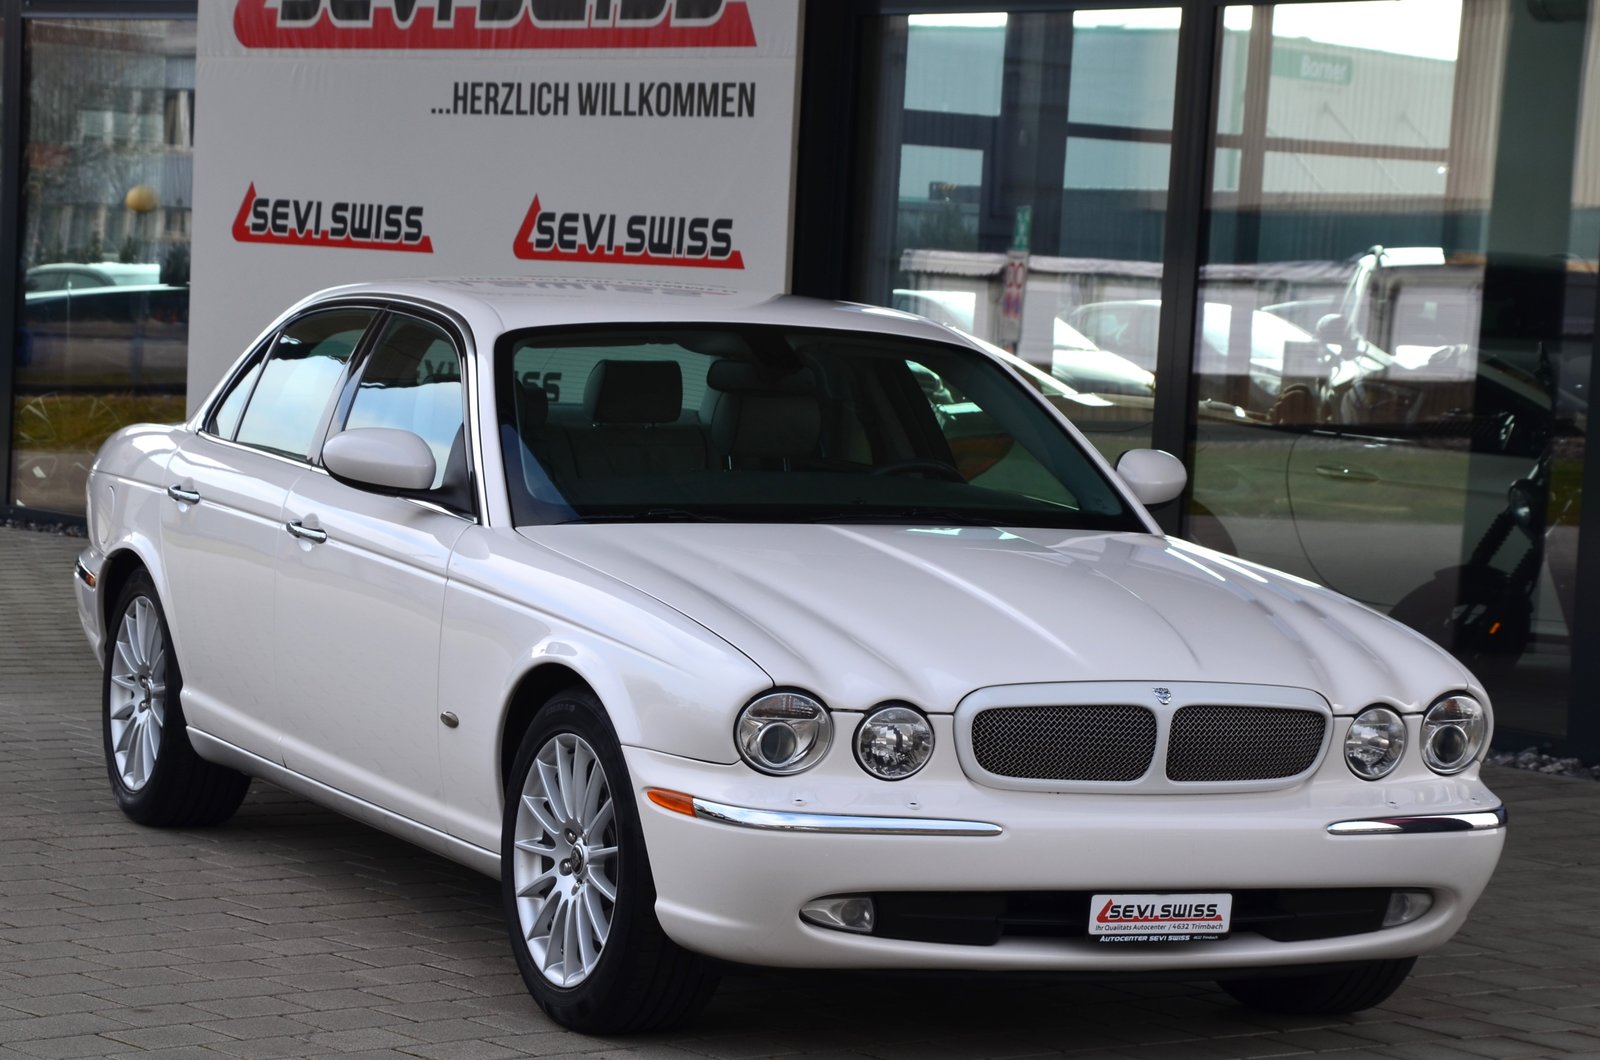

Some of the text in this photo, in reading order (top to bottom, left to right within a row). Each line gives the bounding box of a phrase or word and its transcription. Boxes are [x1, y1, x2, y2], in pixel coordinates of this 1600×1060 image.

[577, 82, 756, 118] WILLKOMMEN
[251, 198, 424, 242] SEVI SWISS
[535, 211, 734, 257] SEVI SWISS
[1109, 903, 1218, 919] SEVI SWISS
[1132, 923, 1166, 931] Autocenter
